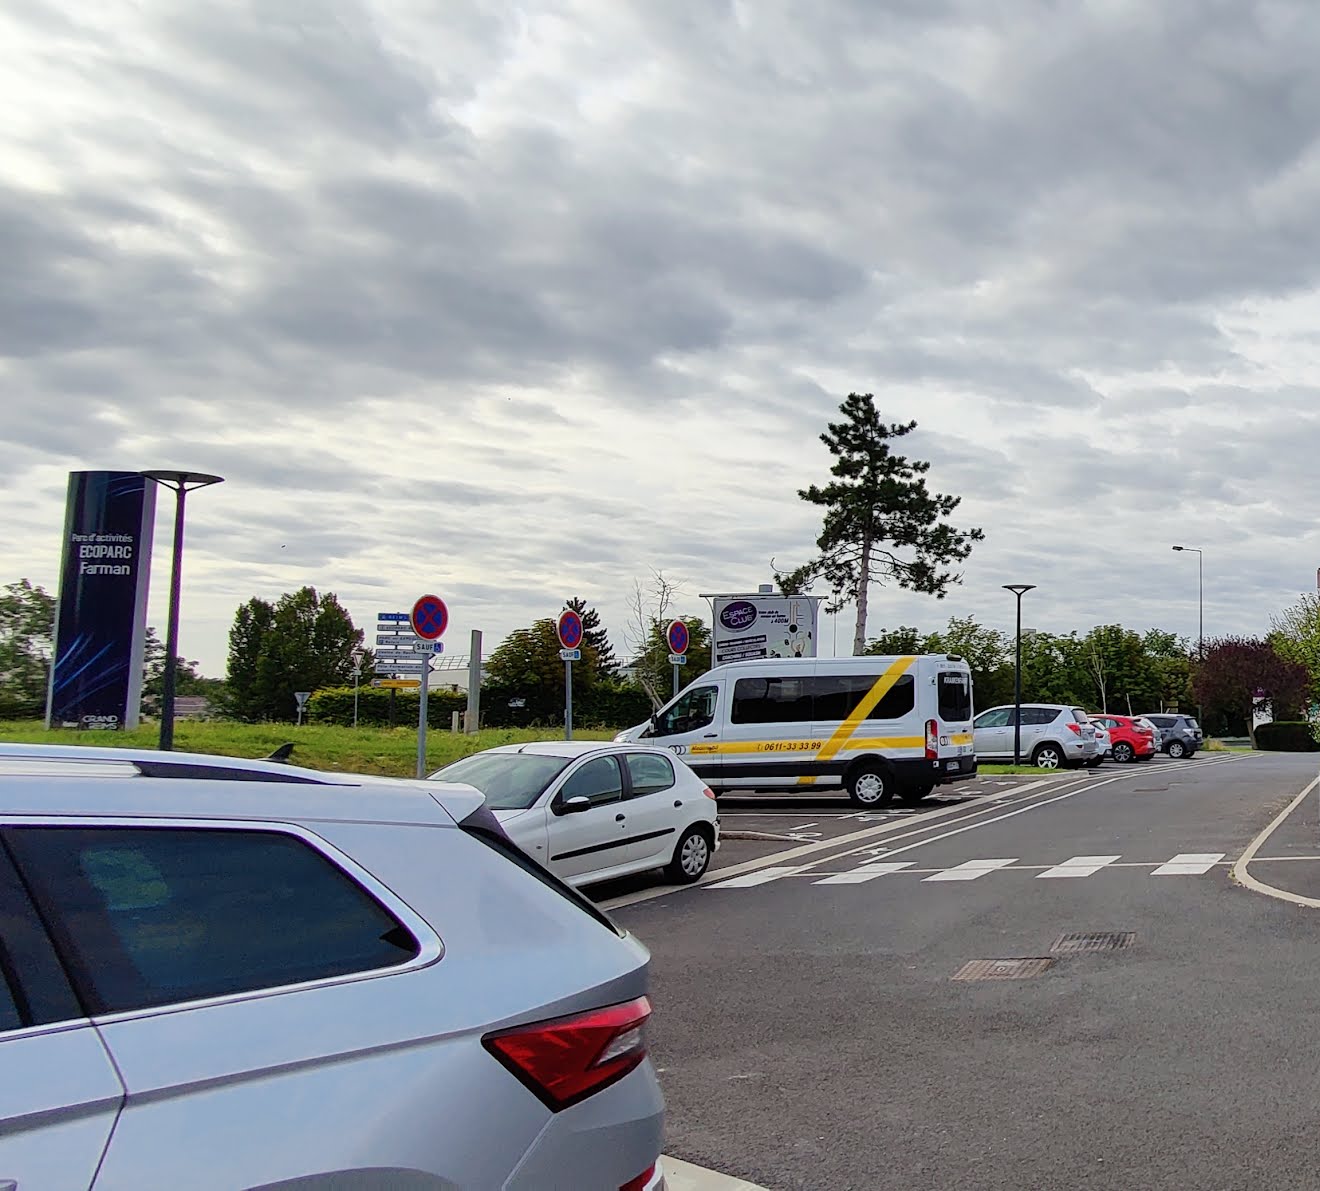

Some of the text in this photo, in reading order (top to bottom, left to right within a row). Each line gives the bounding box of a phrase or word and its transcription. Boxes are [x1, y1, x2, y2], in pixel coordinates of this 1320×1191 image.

[79, 545, 133, 559] ECOPARC
[80, 561, 131, 576] Farman
[722, 606, 753, 620] ESPACE
[730, 615, 753, 626] CLUB
[416, 643, 434, 651] SAUF
[764, 741, 822, 751] 0611-33 33 99
